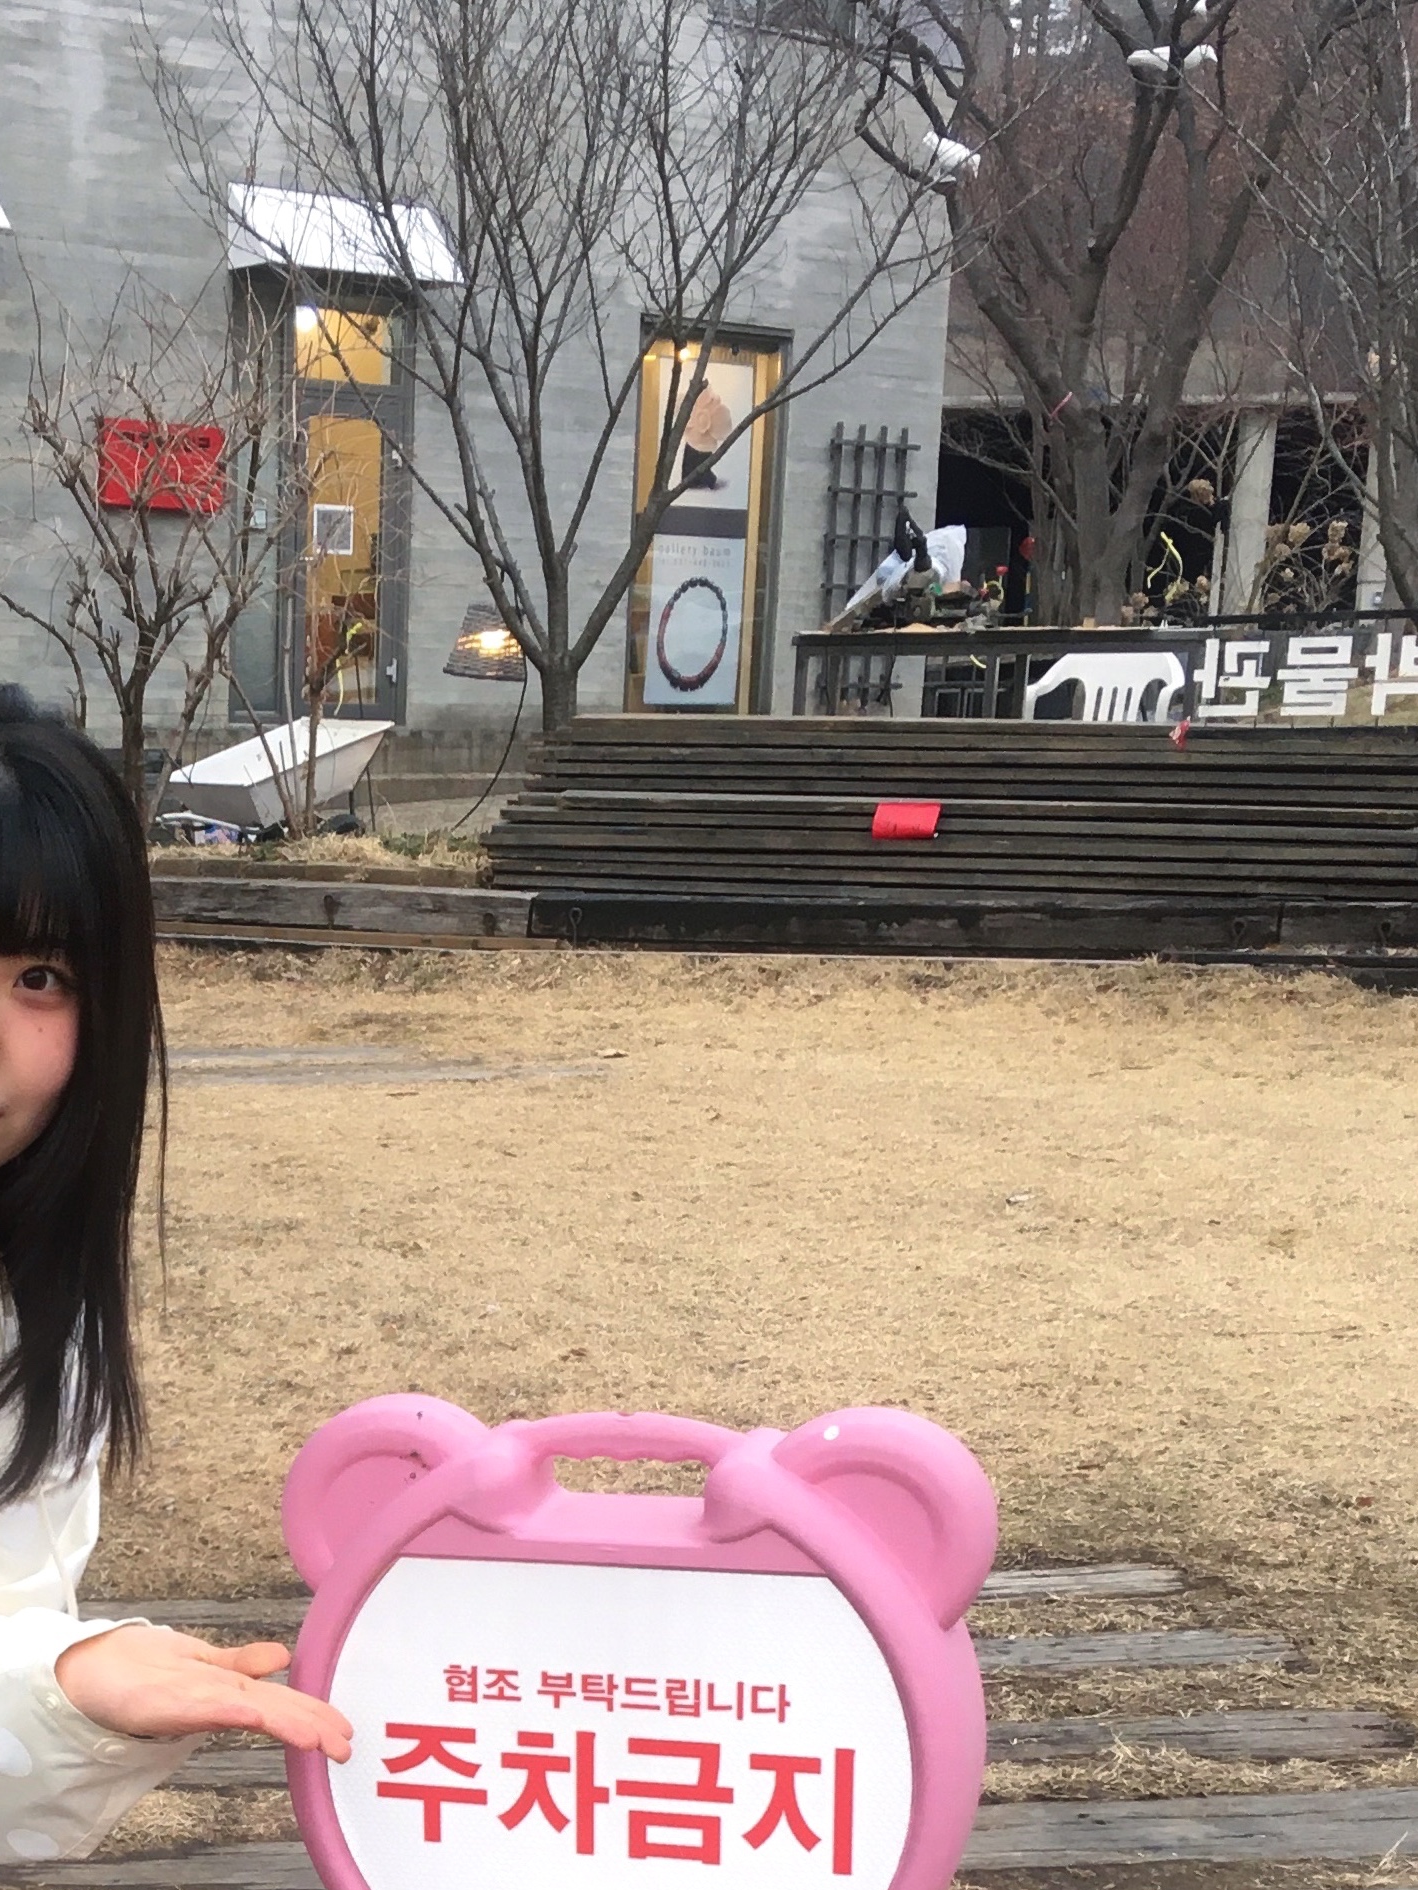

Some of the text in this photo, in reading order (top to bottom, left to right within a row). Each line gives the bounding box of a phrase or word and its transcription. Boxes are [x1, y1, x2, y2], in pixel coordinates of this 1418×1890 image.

[443, 1664, 791, 1723] 협조 부탁드립니다
[376, 1722, 856, 1876] 주차금지
